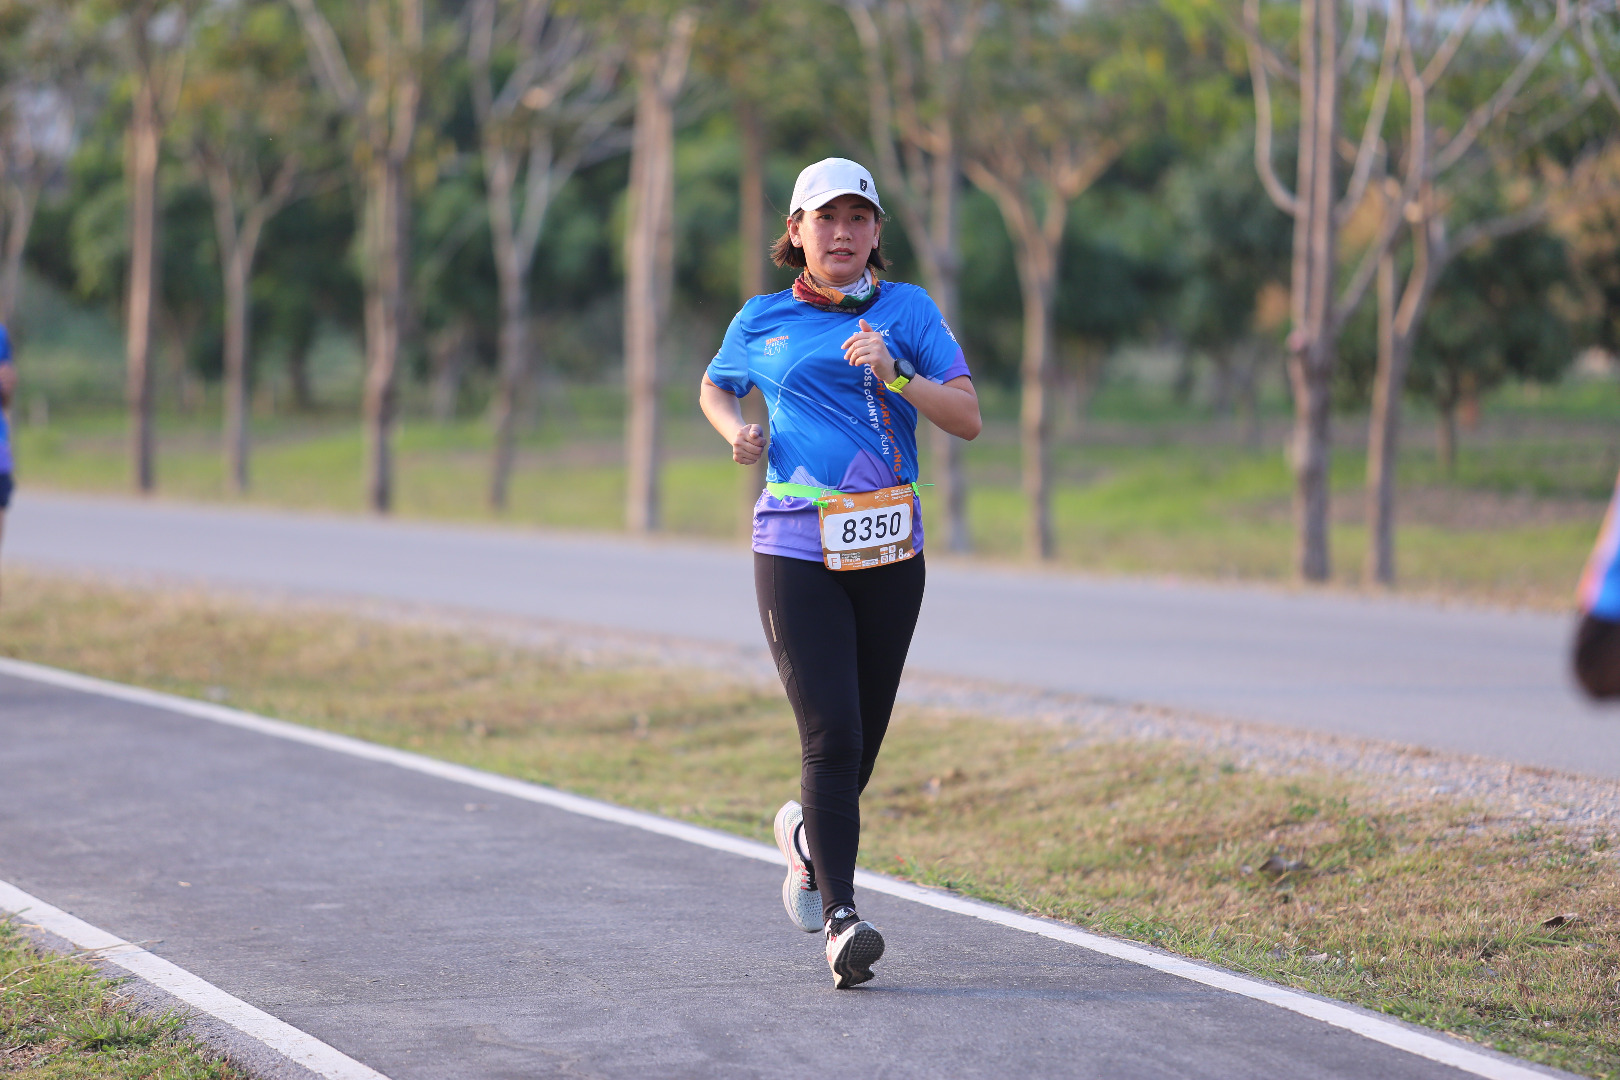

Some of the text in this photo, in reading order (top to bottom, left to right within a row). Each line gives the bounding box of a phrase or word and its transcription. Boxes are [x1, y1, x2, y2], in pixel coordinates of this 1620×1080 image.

[864, 389, 881, 432] COUNTR
[879, 434, 890, 455] RUN
[885, 428, 902, 473] CHANG
[842, 511, 902, 544] 8350
[830, 557, 838, 567] F
